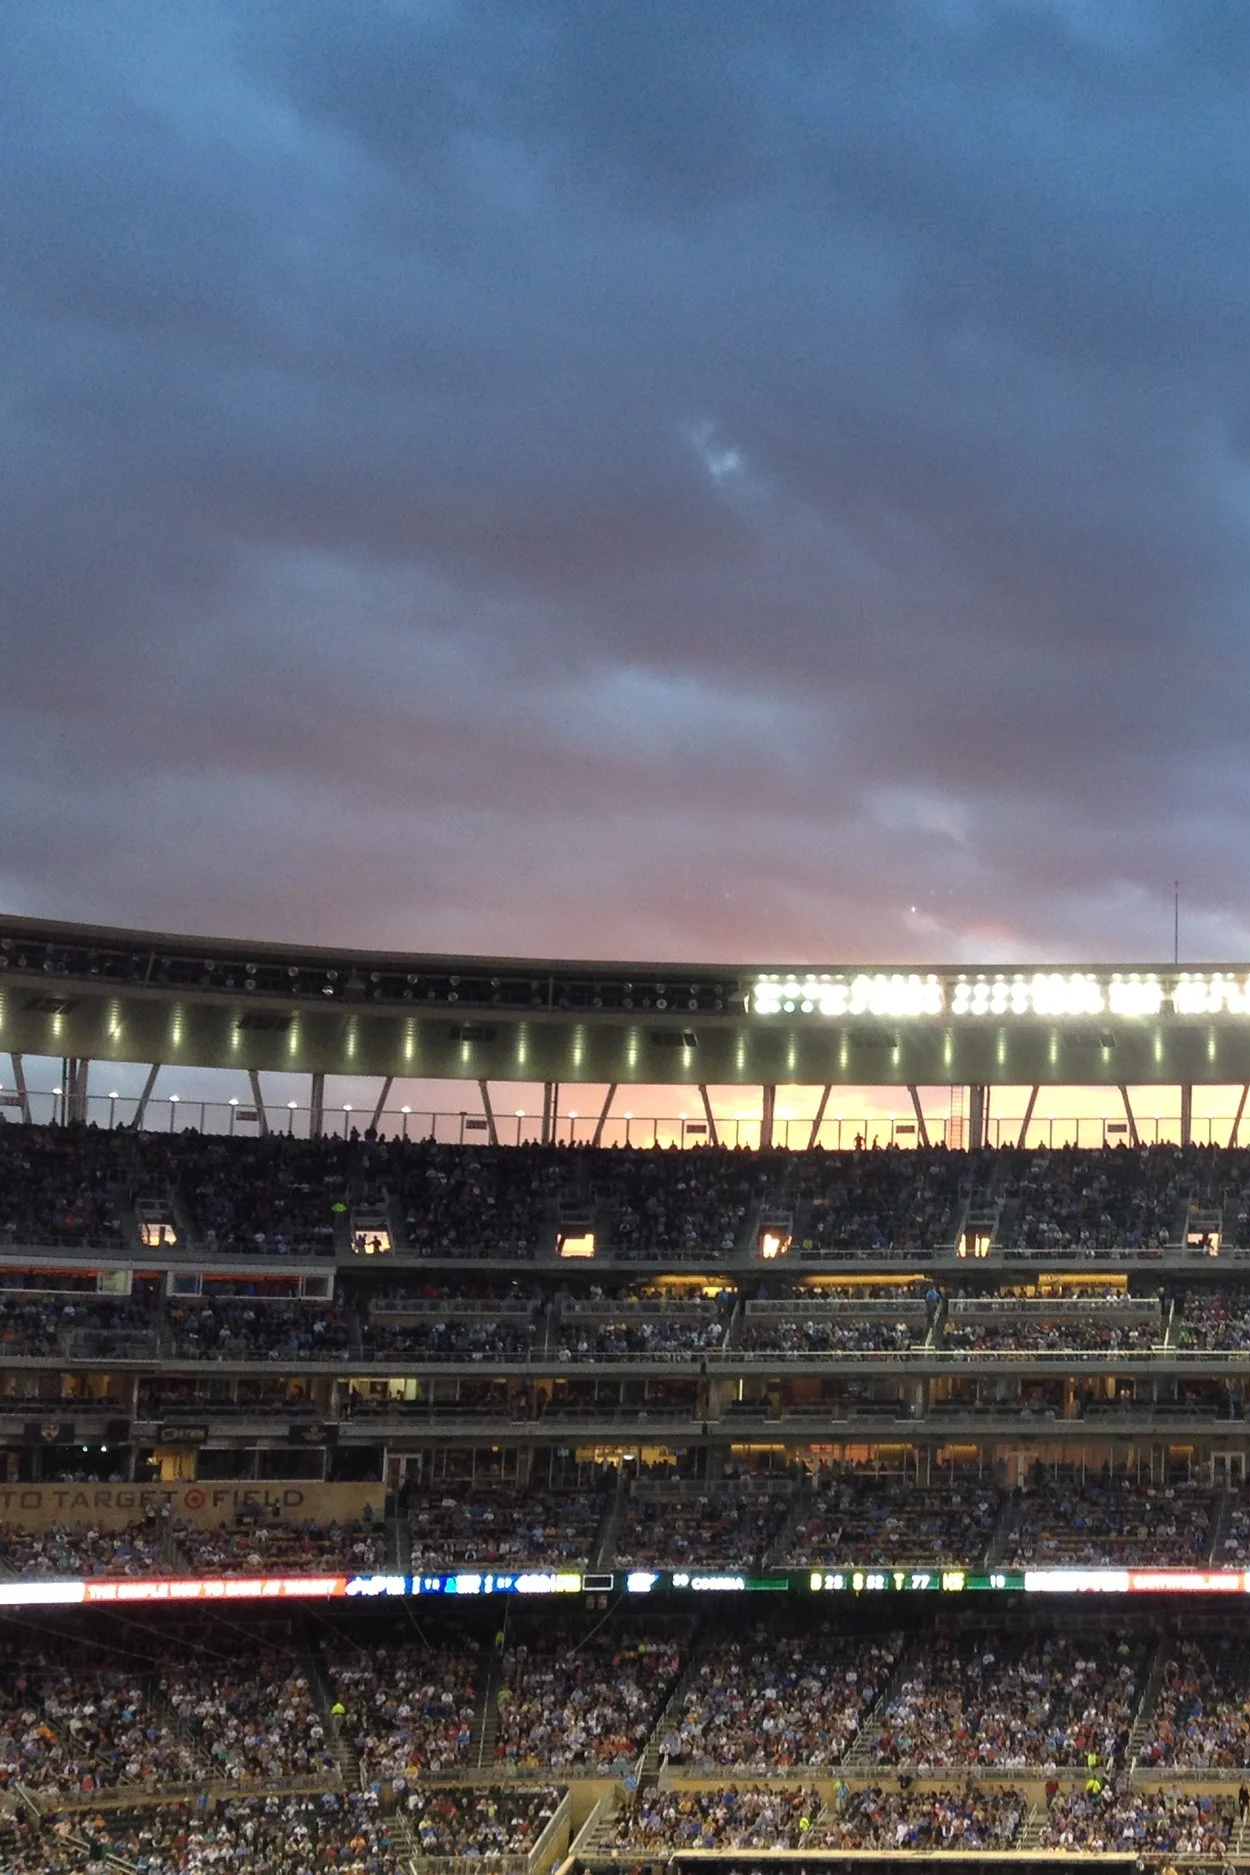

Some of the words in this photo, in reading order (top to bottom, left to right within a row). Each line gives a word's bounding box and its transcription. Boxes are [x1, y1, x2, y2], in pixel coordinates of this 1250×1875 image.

[0, 1490, 42, 1509] TO
[52, 1490, 179, 1509] TARGET
[212, 1489, 305, 1508] FIELD
